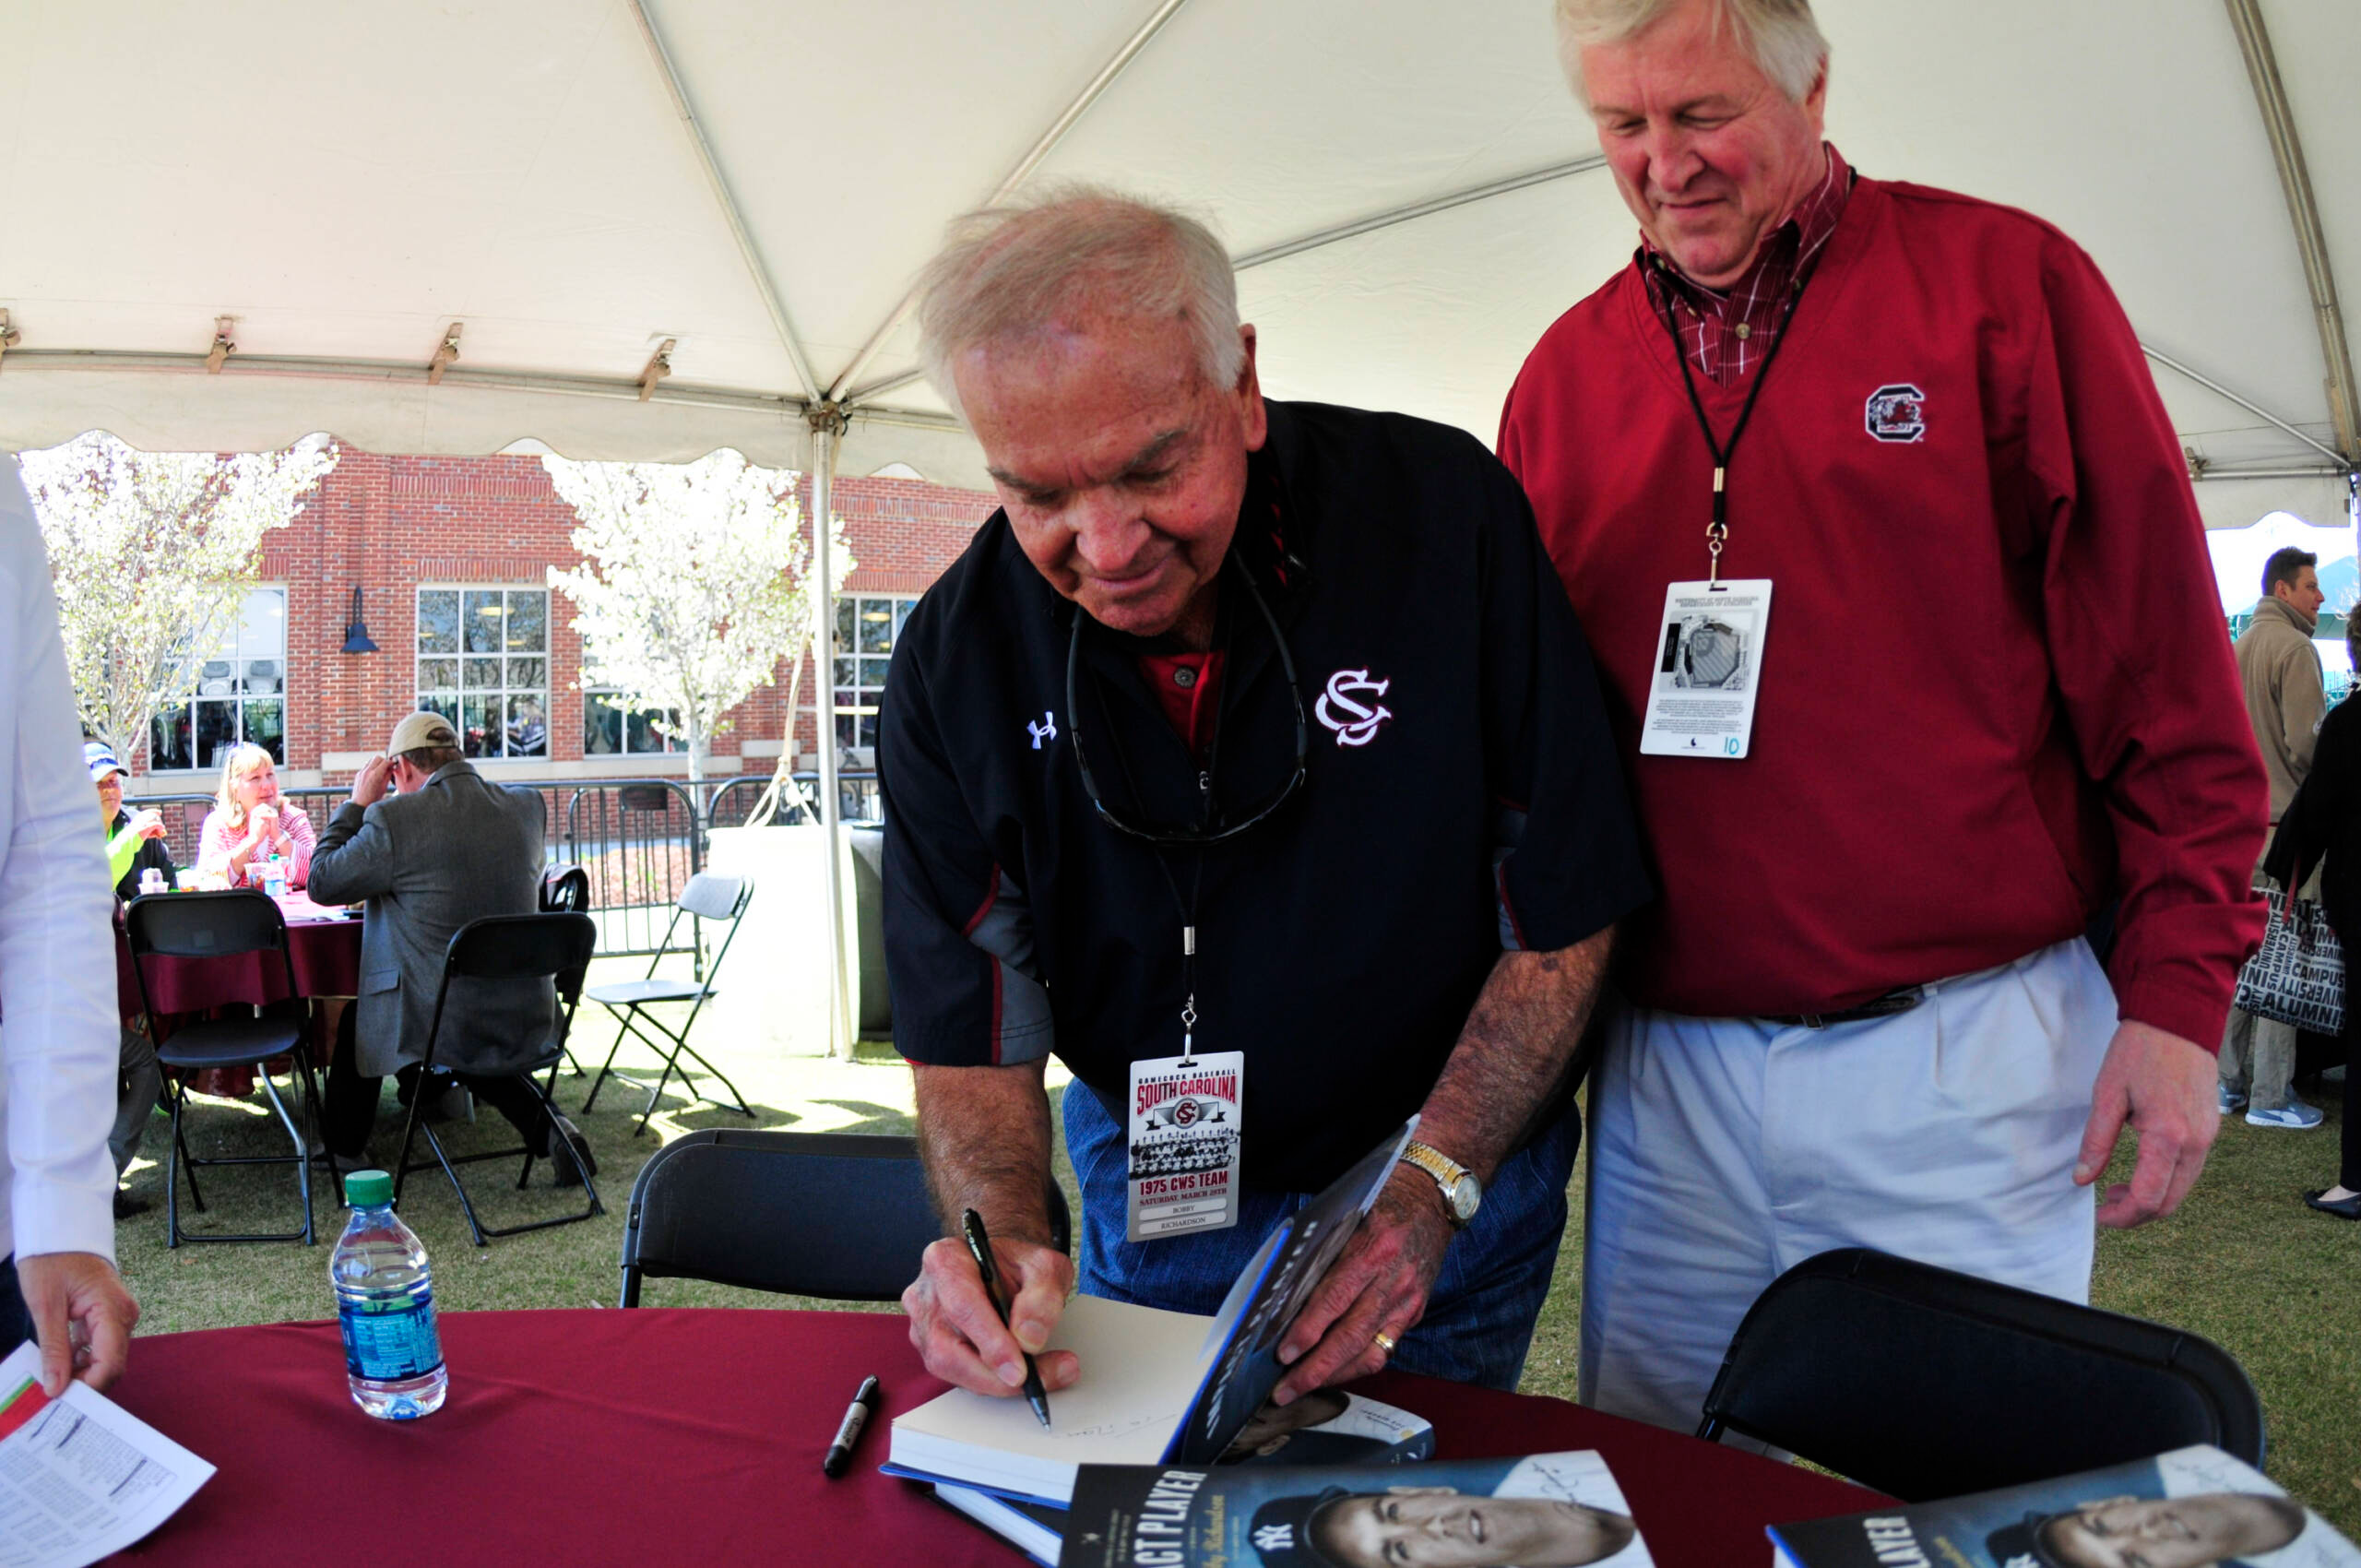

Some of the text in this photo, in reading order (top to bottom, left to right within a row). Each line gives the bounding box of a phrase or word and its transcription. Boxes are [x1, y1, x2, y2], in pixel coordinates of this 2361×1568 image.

[2267, 933, 2289, 990] CAMPUS
[2292, 962, 2345, 988] CAMPUS
[2262, 992, 2340, 1026] ALUMNI
[1138, 1069, 1236, 1084] GAMECOCK BASEBALL
[1136, 1075, 1237, 1116] SOUTH CAROLINA
[1139, 1170, 1228, 1195] 1975 CWS TEAM
[1181, 1190, 1208, 1200] MARCH
[1160, 1218, 1206, 1229] RICHARDSON
[1136, 1470, 1208, 1534] PLAYER
